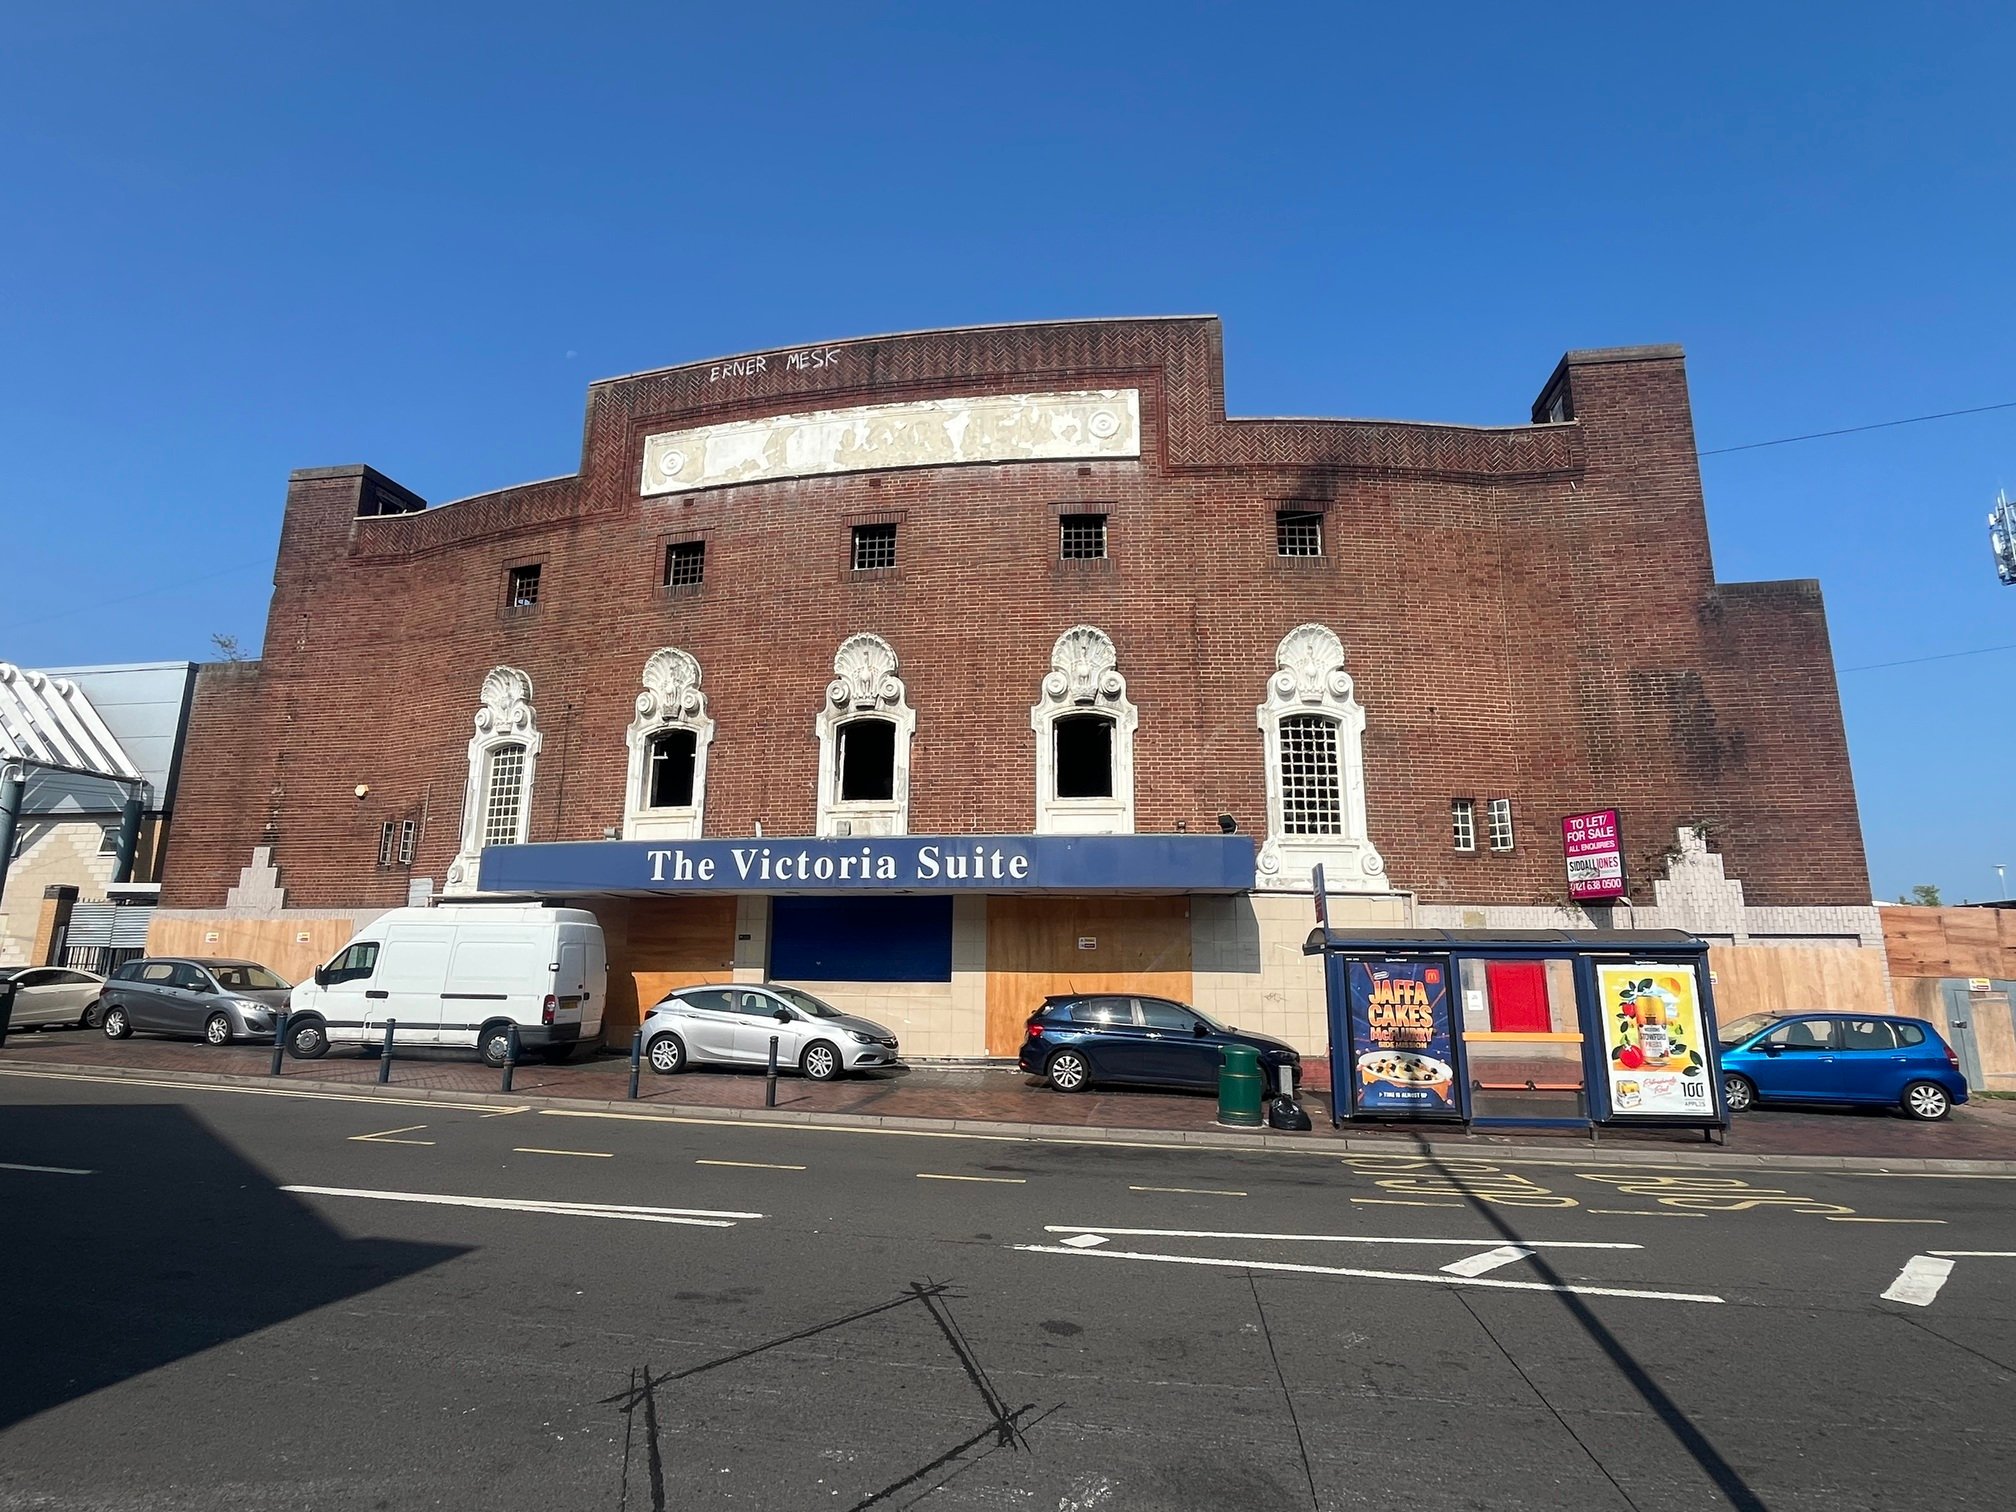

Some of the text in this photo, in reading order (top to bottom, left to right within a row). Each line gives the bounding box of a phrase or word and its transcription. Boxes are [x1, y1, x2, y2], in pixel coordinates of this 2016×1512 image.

[710, 348, 841, 382] ERNER MESK
[1570, 819, 1584, 830] TO
[1567, 826, 1614, 842] FOR SALE
[1569, 840, 1615, 853] ALL ENQUIRIES
[647, 845, 1029, 881] The Victoria Suite
[1587, 880, 1601, 890] 638
[1602, 879, 1621, 889] 0500
[1368, 979, 1429, 1005] JAFFA
[1368, 1004, 1434, 1027] CAKES
[1680, 1082, 1704, 1098] 100
